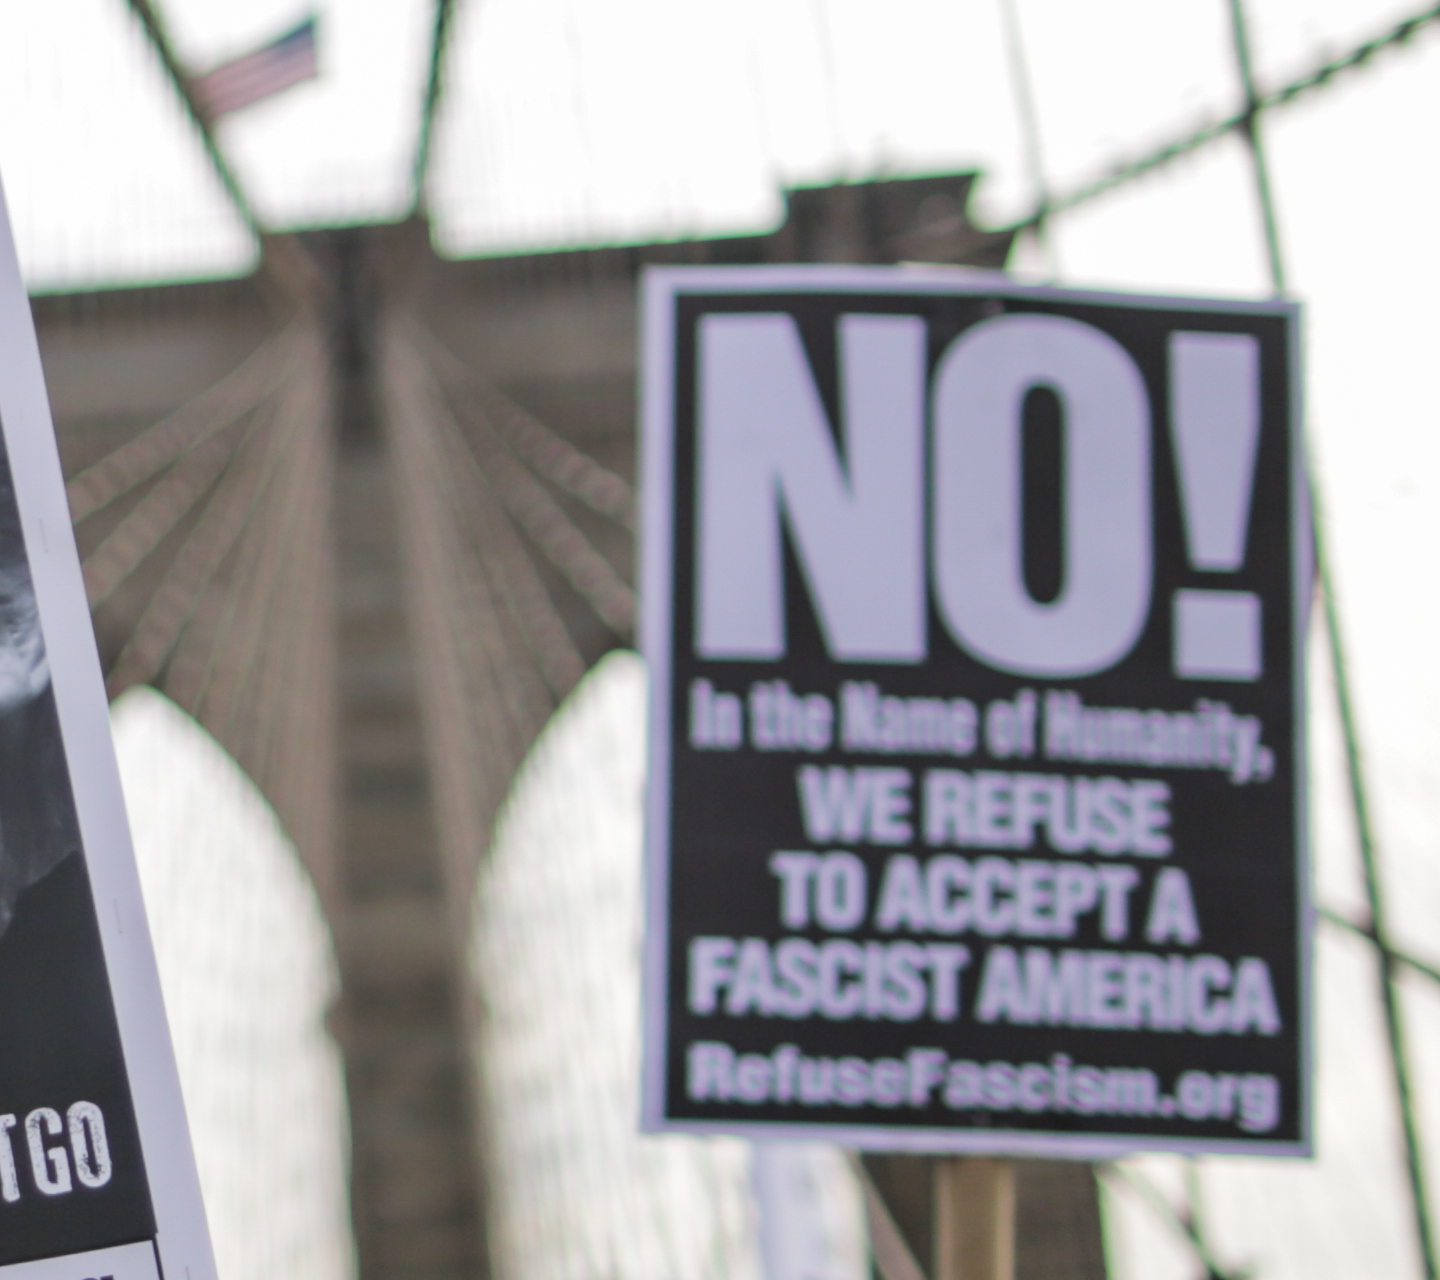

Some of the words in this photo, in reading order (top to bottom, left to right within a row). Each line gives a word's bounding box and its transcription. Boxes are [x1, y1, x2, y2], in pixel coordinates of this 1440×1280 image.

[696, 313, 1262, 680] NO!
[691, 681, 743, 748] In
[752, 684, 832, 751] the
[843, 686, 976, 756] Name
[987, 691, 1035, 756] of
[799, 767, 912, 842] WE
[925, 771, 1171, 857] REFUSE
[772, 852, 866, 929] TO
[877, 857, 1139, 942] ACCEPT
[1149, 868, 1198, 944] A
[690, 938, 969, 1019] FASCIST
[978, 949, 1279, 1035] AMERICA
[688, 1044, 1279, 1130] RefuseFascism.org
